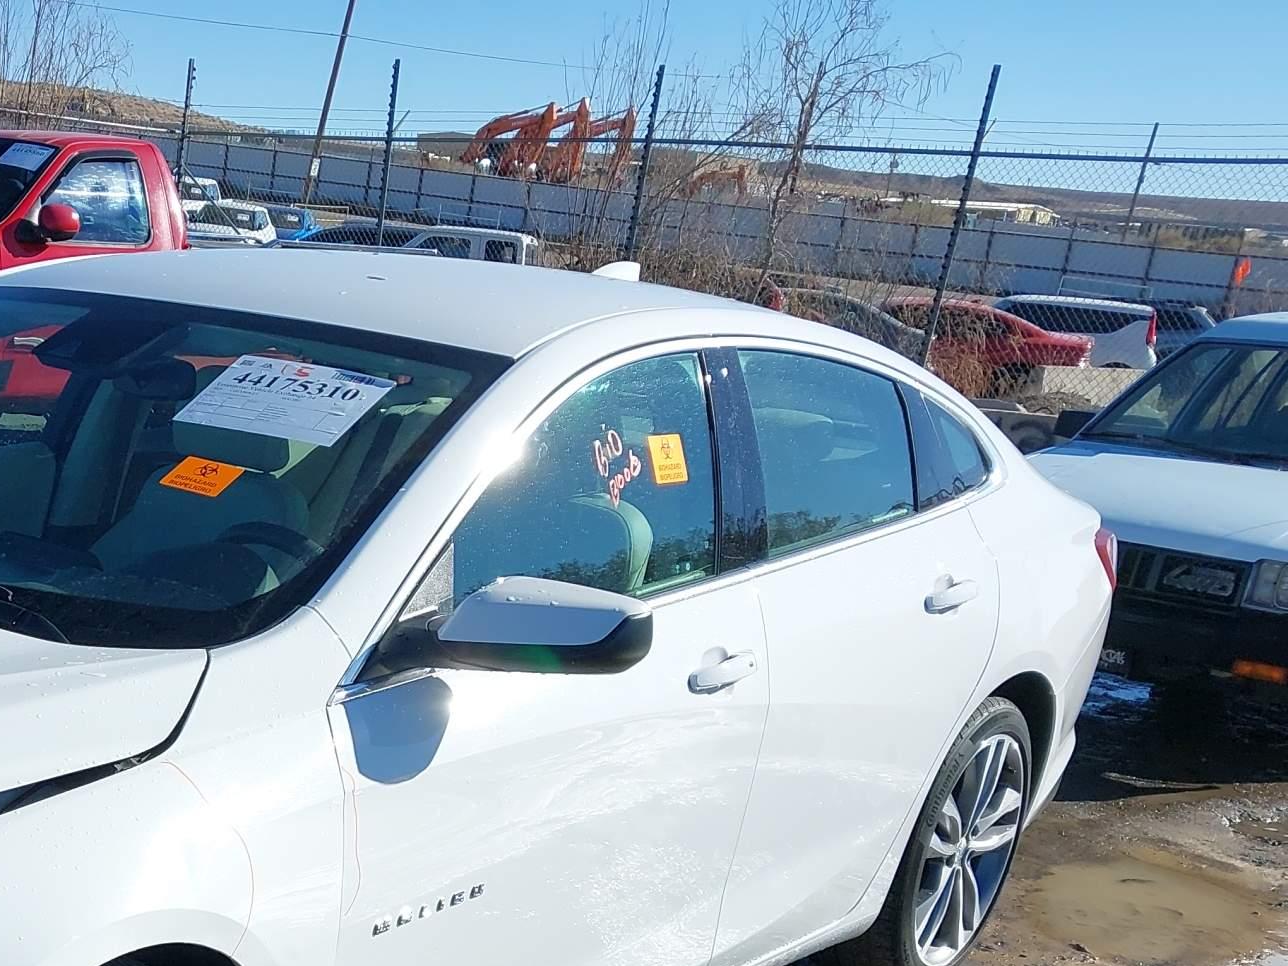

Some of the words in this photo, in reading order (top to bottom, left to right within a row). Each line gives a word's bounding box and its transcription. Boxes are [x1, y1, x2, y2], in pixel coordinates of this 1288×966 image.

[233, 372, 360, 401] 44175310
[175, 473, 217, 488] BIOHAZARD
[926, 758, 960, 828] Continental
